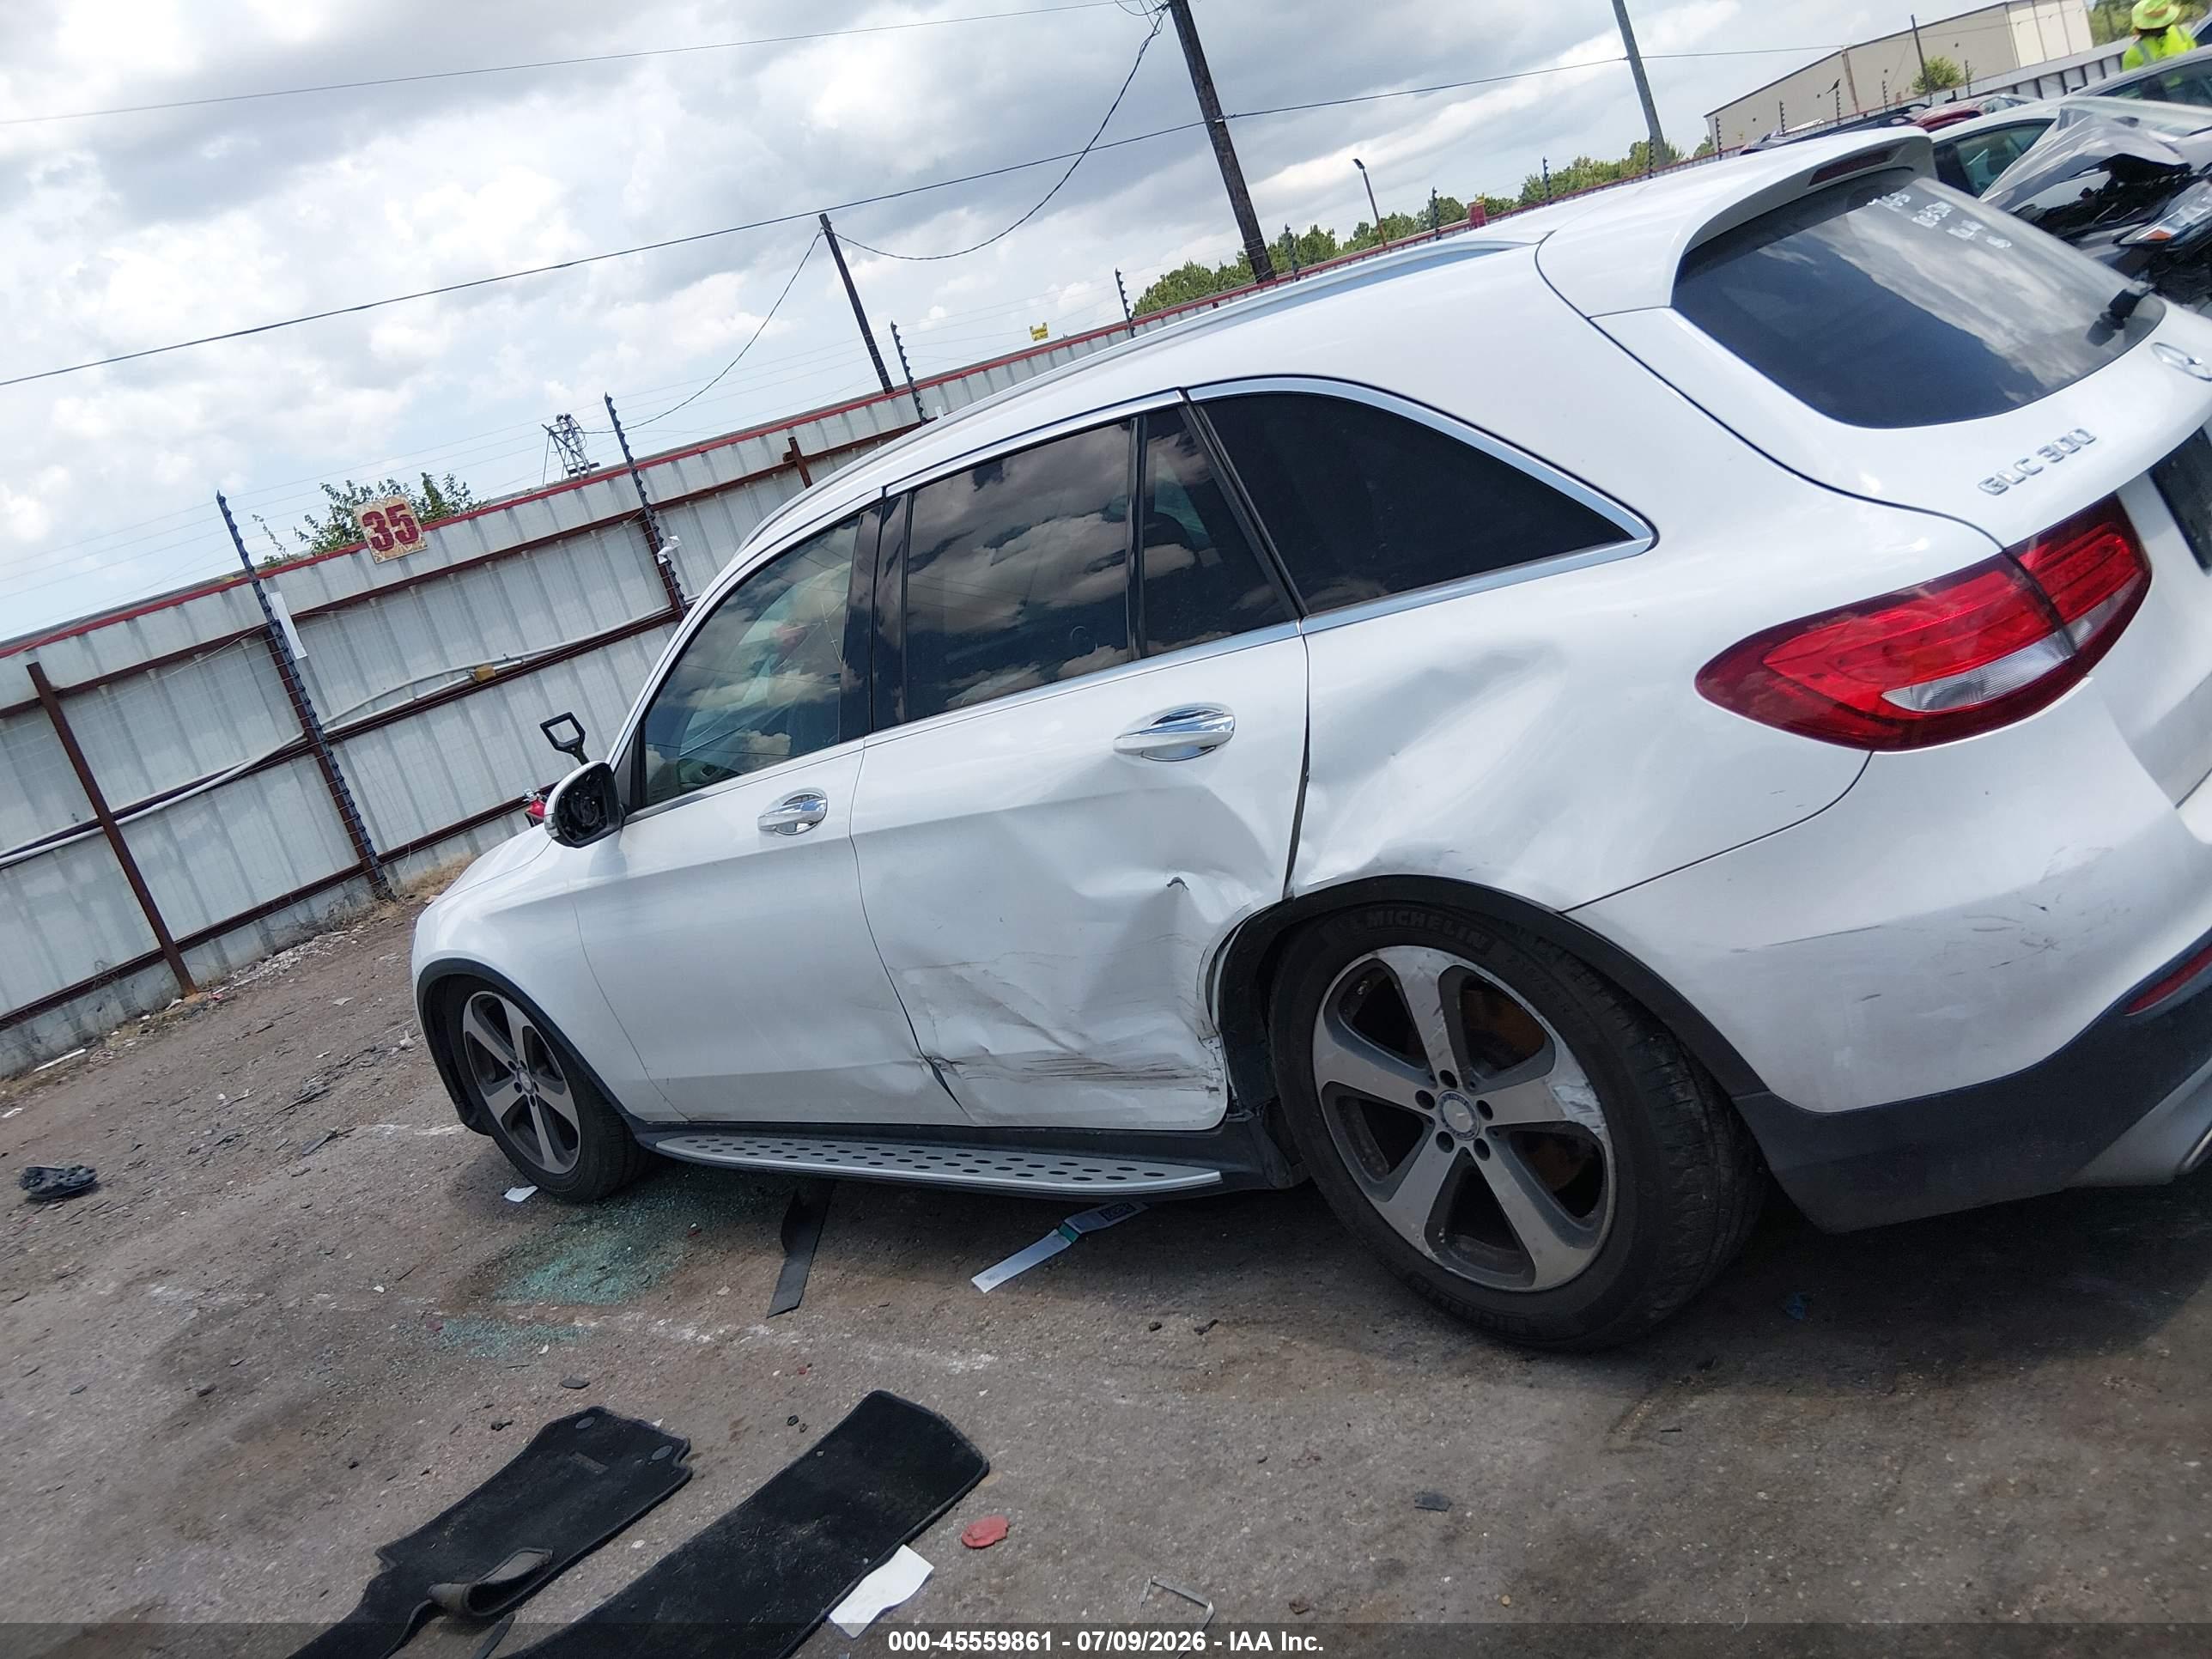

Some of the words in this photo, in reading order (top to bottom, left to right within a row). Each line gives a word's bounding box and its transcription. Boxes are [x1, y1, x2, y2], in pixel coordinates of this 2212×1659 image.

[1977, 458, 2045, 496] GLC
[2036, 428, 2097, 464] 300
[362, 503, 419, 551] 35
[1366, 909, 1490, 949] MICHELIN
